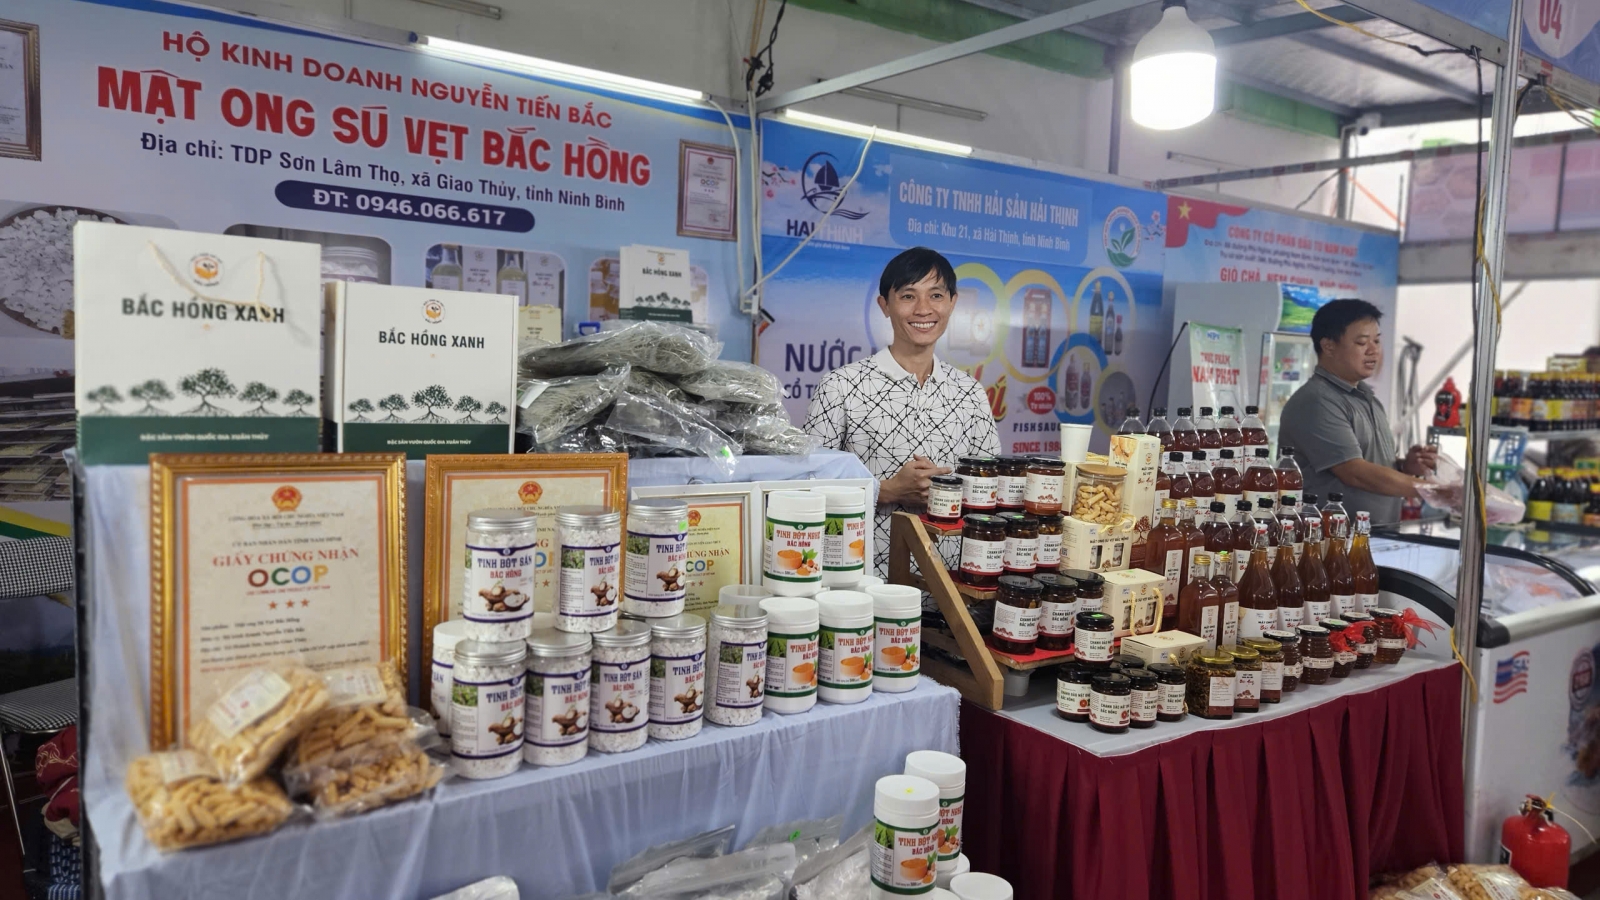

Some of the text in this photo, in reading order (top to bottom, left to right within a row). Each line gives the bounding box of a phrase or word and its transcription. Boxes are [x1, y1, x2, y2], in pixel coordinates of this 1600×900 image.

[1539, 0, 1562, 39] 04
[163, 30, 612, 129] HỘ KINH DOANH NGUYỄN TIẾN BẮC
[98, 65, 651, 187] MẬT ONG SÚ VẸT BẮC HỒNG
[140, 132, 625, 212] Địa chỉ: TDP Sơn Lâm Thọ, xã Giao Thủy, tỉnh Ninh Bình
[312, 188, 507, 226] ĐT: 0946.066.617
[899, 179, 1079, 229] CÔNG TY TNHH HẢI SẢN HẢI THỊNH
[907, 218, 922, 236] Địa
[941, 222, 957, 237] Khu
[958, 225, 971, 241] 21,
[973, 227, 982, 240] xã
[984, 227, 997, 242] Hải
[121, 293, 164, 317] BẮC
[379, 327, 406, 344] BẮC
[451, 335, 484, 349] XANH
[1012, 440, 1061, 454] SINCE 198
[776, 530, 791, 540] TINH
[656, 544, 674, 553] TINH
[212, 545, 359, 568] GIẤY CHỨNG NHẬN
[477, 558, 497, 568] TINH
[686, 560, 714, 572] COP
[247, 564, 329, 588] OCOP
[878, 626, 908, 636] TINH BỘT
[790, 644, 806, 653] TINH
[838, 637, 855, 647] TINH
[673, 665, 691, 676] TINH
[603, 673, 618, 682] TINH
[551, 684, 572, 695] TINH
[486, 692, 508, 703] TINH
[898, 837, 916, 847] TINH
